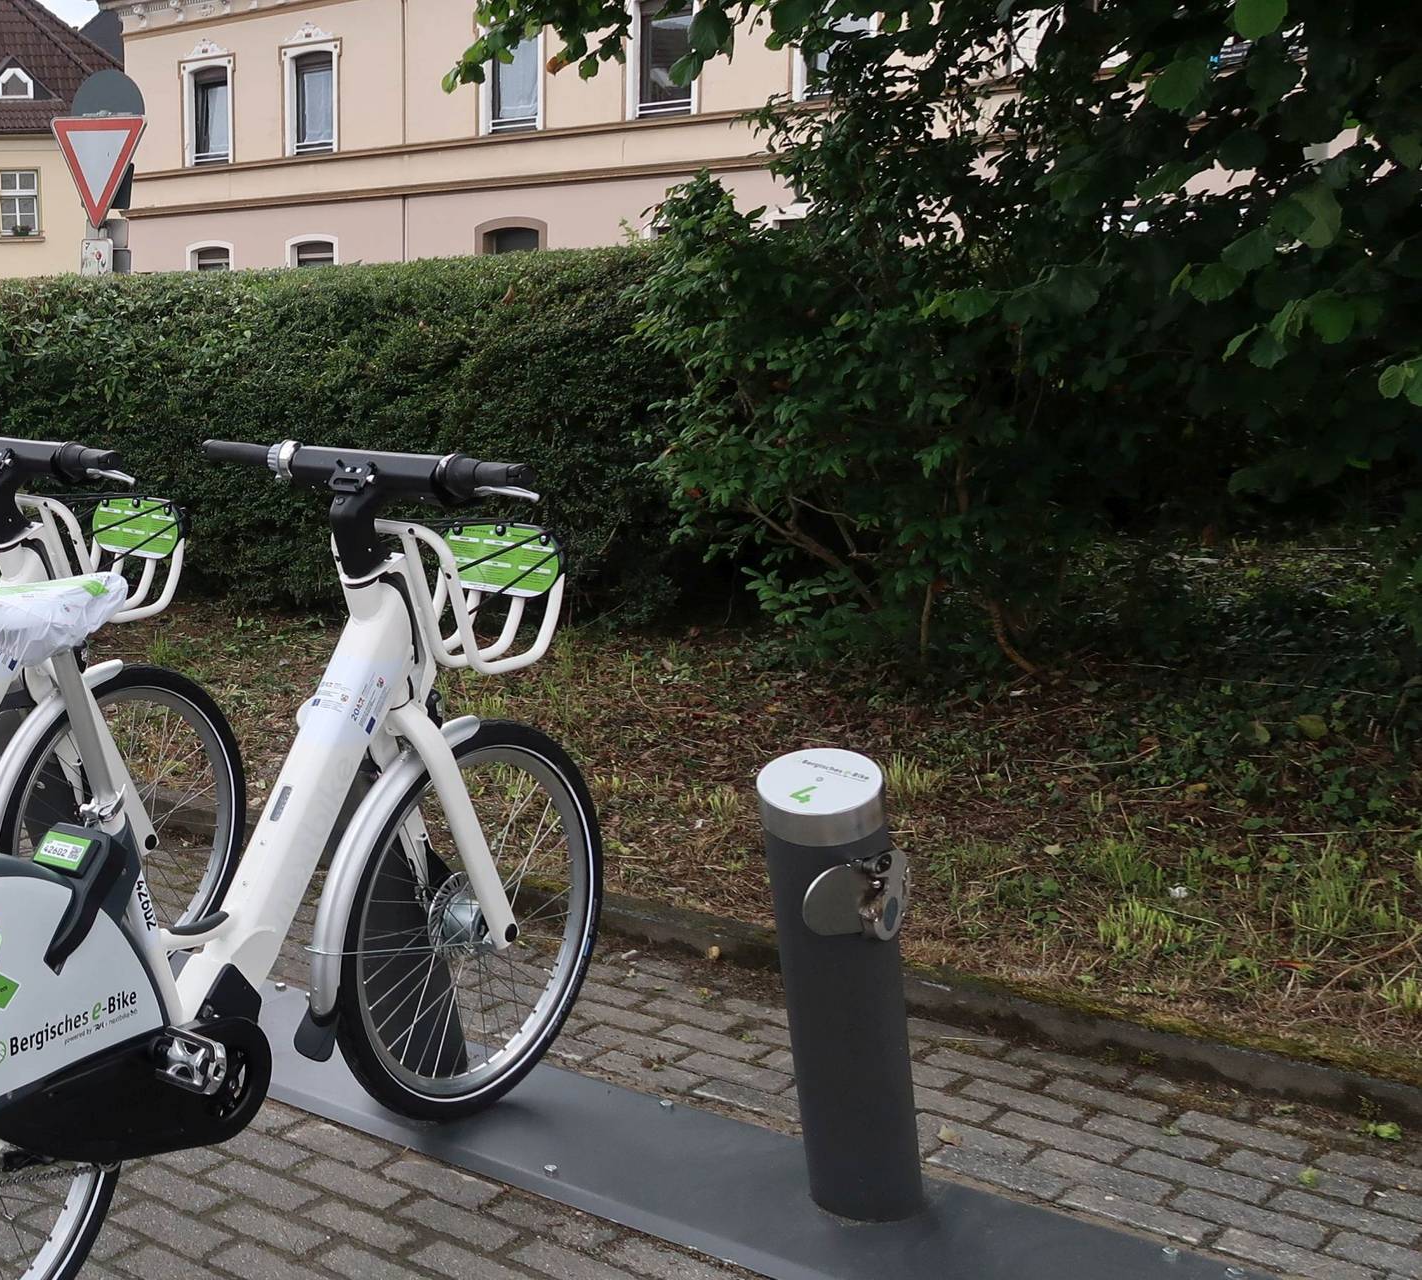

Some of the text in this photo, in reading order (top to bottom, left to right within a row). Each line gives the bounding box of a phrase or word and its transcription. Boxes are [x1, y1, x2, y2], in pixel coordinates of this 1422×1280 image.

[43, 845, 68, 857] 42602
[135, 880, 157, 931] 42602
[9, 990, 137, 1057] Bergisches e-Bike
